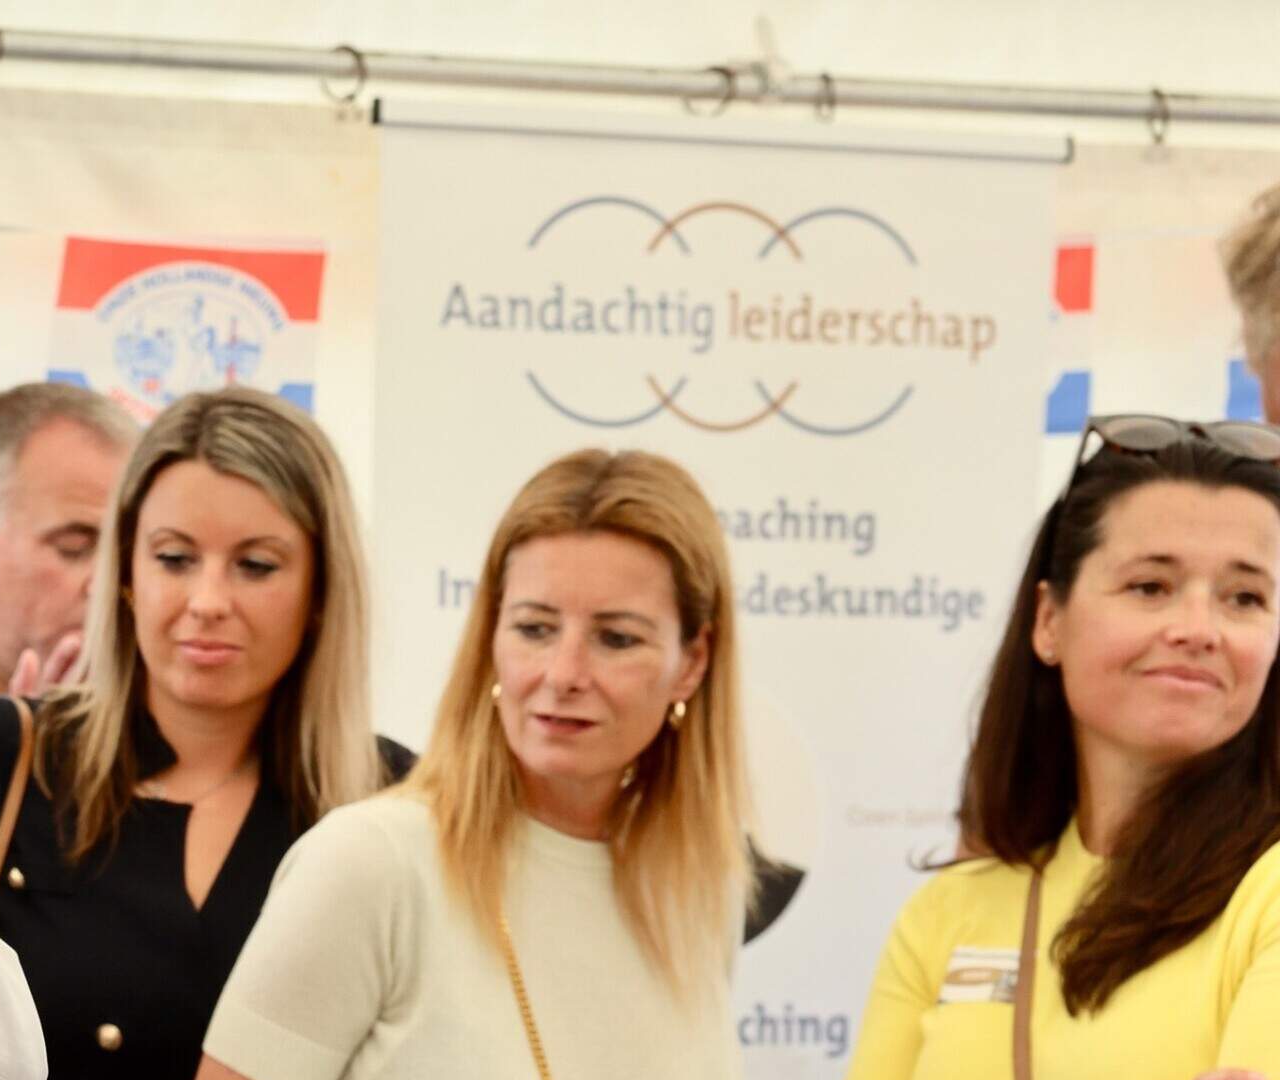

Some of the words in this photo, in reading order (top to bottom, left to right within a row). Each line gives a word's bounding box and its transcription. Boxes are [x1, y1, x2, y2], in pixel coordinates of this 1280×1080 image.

[440, 284, 715, 353] Aandachtig
[727, 291, 998, 362] leiderschap
[743, 574, 987, 630] deskundige
[738, 1003, 850, 1059] ching
